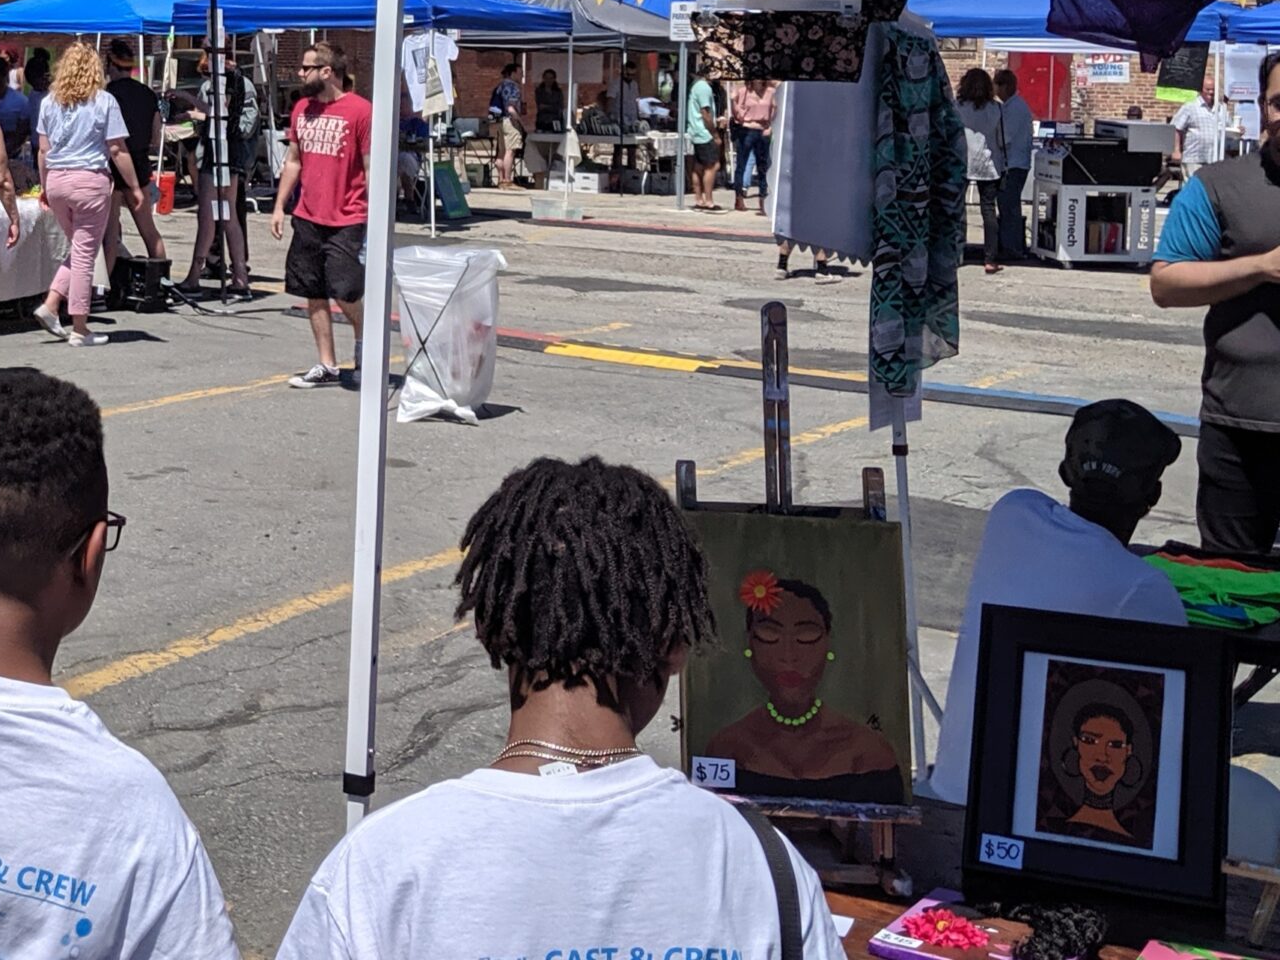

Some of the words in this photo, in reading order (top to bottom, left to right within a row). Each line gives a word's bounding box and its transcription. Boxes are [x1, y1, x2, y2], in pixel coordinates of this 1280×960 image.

[1067, 198, 1079, 248] Formech
[1137, 200, 1150, 250] Formech
[696, 762, 730, 782] $75
[985, 839, 1020, 860] $50
[17, 866, 97, 907] CREW
